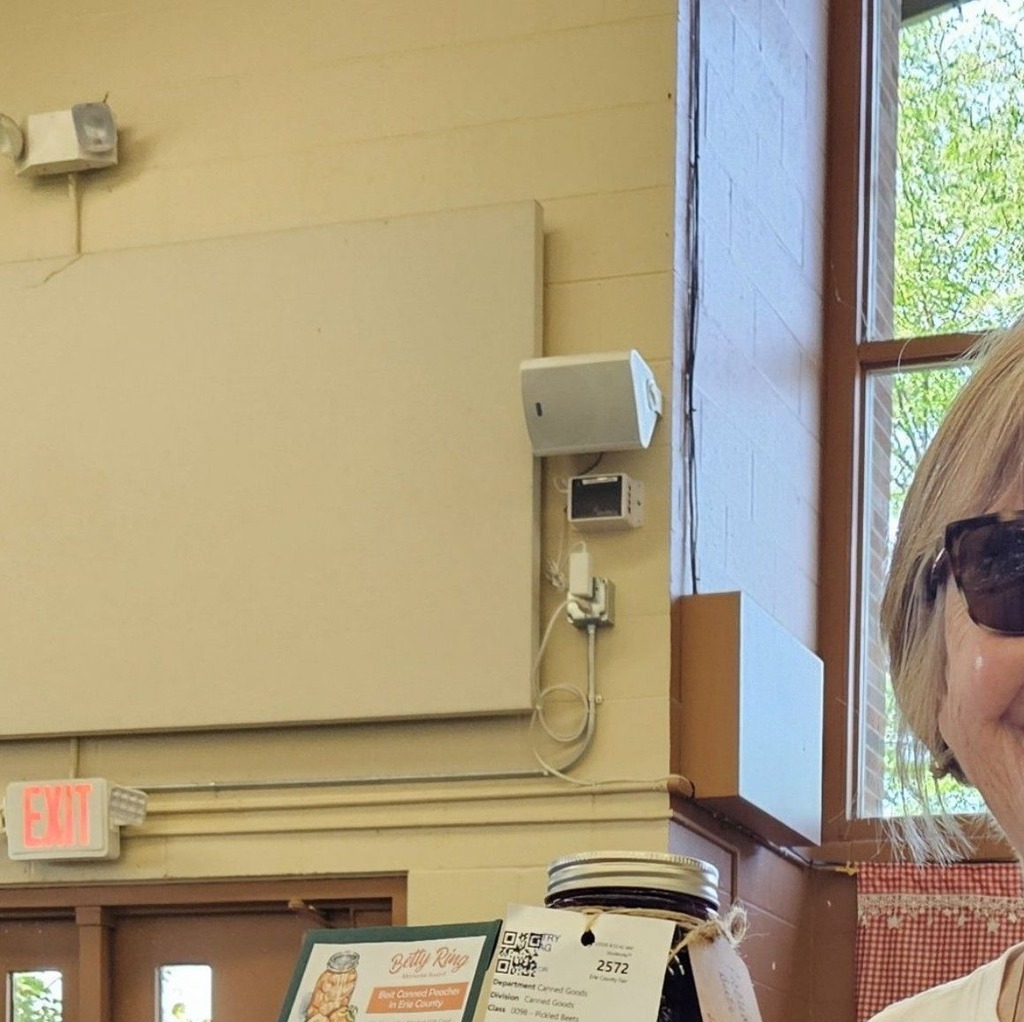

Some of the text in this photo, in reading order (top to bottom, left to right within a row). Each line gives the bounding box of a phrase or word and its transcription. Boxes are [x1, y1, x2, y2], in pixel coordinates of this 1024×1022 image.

[23, 783, 93, 848] EXIT
[389, 947, 469, 974] Betty Ring
[596, 960, 629, 975] 2572
[378, 987, 460, 999] Best Canned Peaches
[493, 978, 588, 997] Department Canned Goods
[398, 1000, 413, 1008] Erie
[415, 999, 443, 1009] County
[490, 991, 574, 1009] Division Canned Goods
[488, 1004, 506, 1013] Class
[535, 1010, 559, 1020] Pickled
[560, 1014, 579, 1022] Beets
